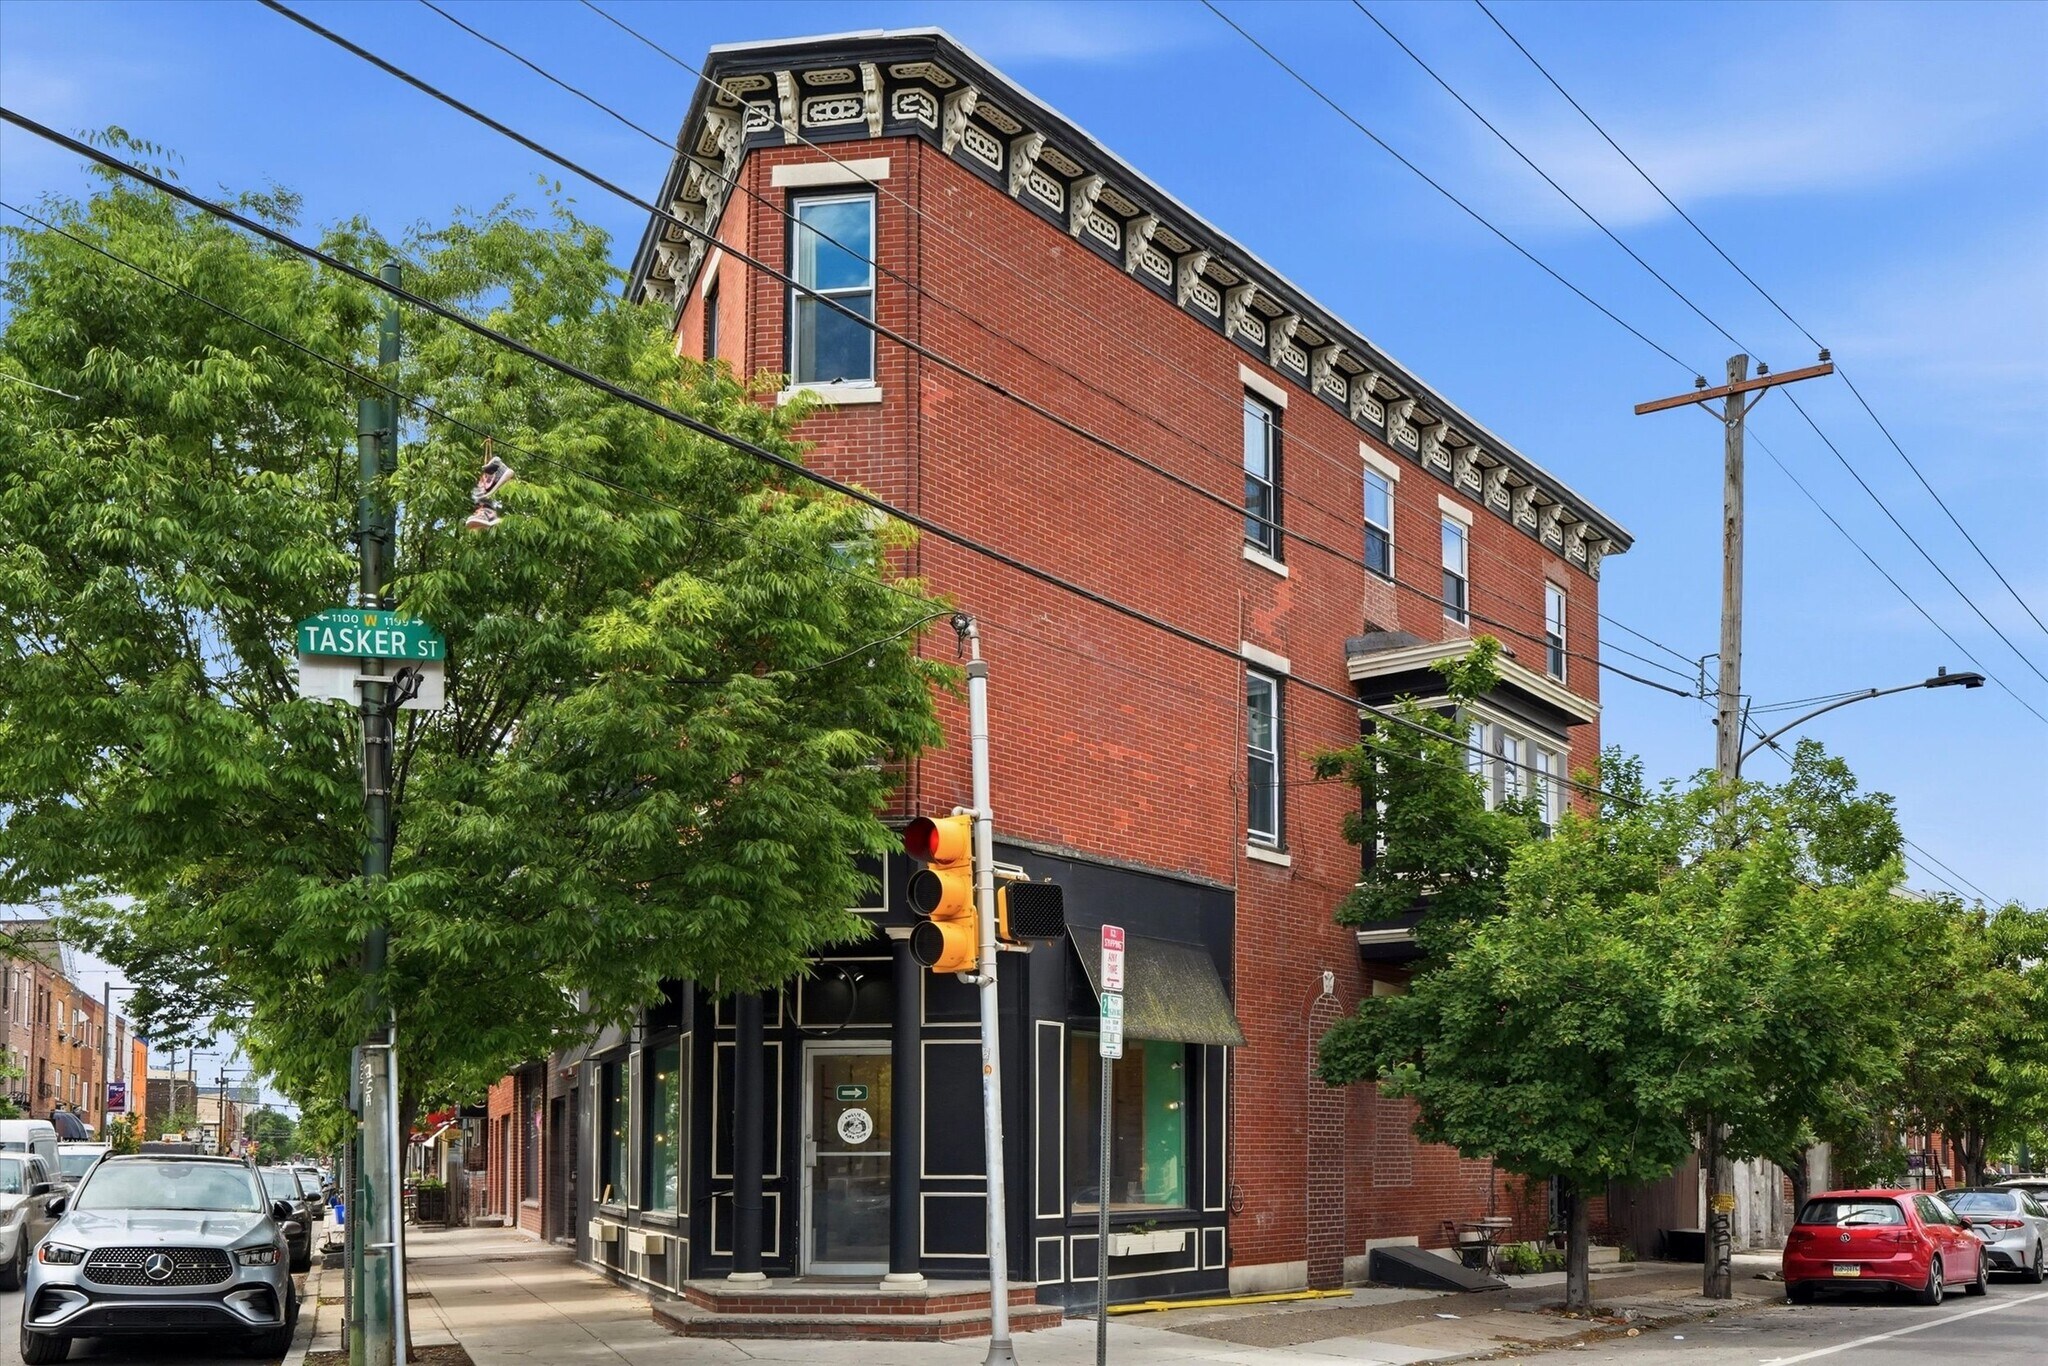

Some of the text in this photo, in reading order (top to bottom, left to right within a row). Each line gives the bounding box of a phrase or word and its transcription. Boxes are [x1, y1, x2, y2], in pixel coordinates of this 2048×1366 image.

[332, 614, 358, 623] 1100
[364, 614, 378, 627] W
[305, 626, 438, 657] TASKER ST
